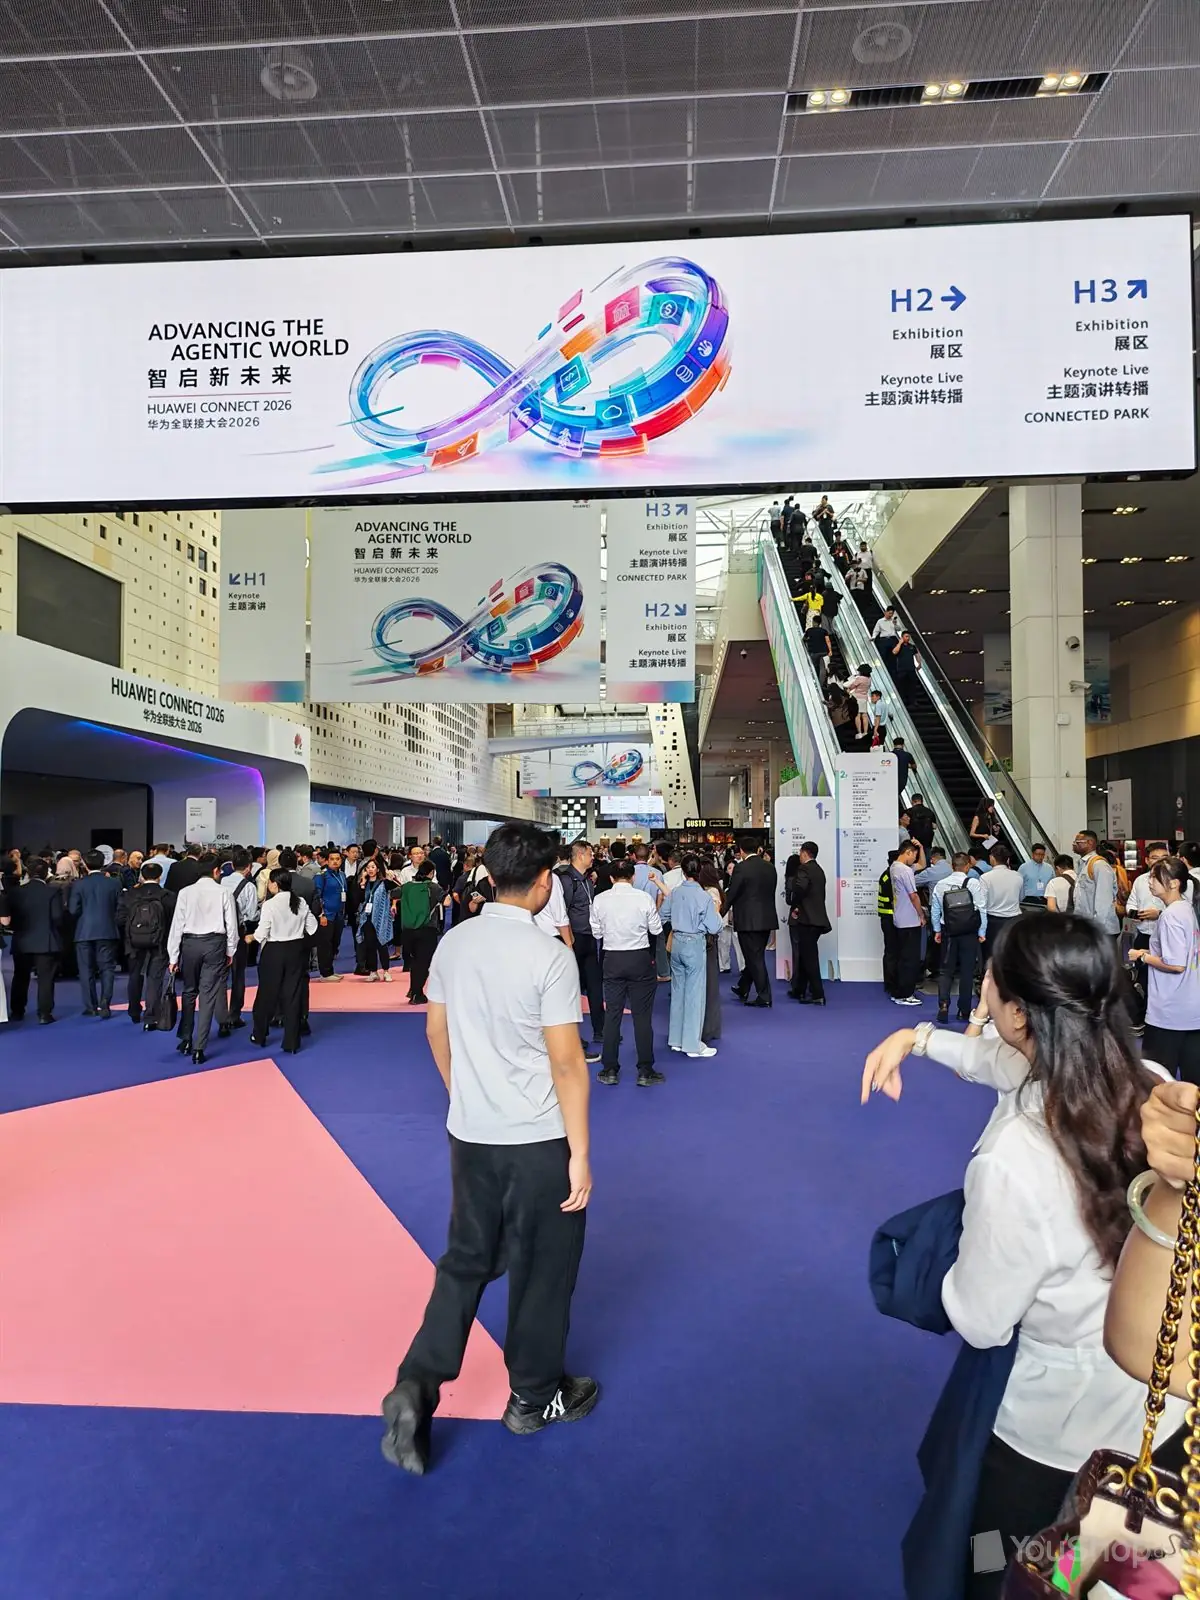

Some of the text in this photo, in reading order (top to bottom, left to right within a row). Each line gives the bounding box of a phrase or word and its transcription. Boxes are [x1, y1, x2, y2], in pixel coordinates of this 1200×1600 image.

[1073, 279, 1118, 304] H3
[890, 288, 934, 313] H2
[148, 318, 324, 341] ADVANCING THE
[1075, 318, 1149, 333] Exhibition
[892, 327, 964, 341] Exhibition
[171, 338, 349, 361] AGENTIC WORLD
[1114, 335, 1149, 351] 展区
[930, 344, 964, 359] 展区
[147, 364, 292, 389] 智启新未来
[1063, 364, 1149, 379] Keynote Live
[881, 372, 964, 387] Keynote Live
[864, 388, 964, 406] 主题演讲转播
[1046, 380, 1149, 400] 主题演讲转播
[147, 399, 292, 415] HUAWEI CONNECT 2026
[1024, 407, 1150, 423] CONNECTED PARK
[147, 416, 260, 430] 华为全联接大会2026
[646, 503, 671, 517] H3
[354, 521, 457, 533] ADVANCING THE
[646, 523, 688, 531] Exhibition
[367, 533, 472, 544] AGENTIC WORLD
[668, 533, 688, 542] 展区
[354, 547, 439, 560] 智启新未来
[639, 549, 670, 557] Keynote
[629, 558, 687, 568] 主题演讲转播
[385, 567, 420, 575] CONNECT
[616, 573, 687, 582] CONNECTED PARK
[244, 572, 266, 586] H1
[228, 592, 260, 600] Keynote
[228, 601, 266, 611] 主题演讲
[645, 603, 670, 617] H2
[645, 623, 687, 631] Exhibition
[667, 633, 687, 642] 展区
[638, 648, 687, 657] Keynote Live
[629, 658, 686, 668] 主题演讲转播
[111, 677, 225, 723] HUAWEI CONNECT 2026
[187, 719, 202, 734] 2026
[815, 802, 830, 820] 1F
[686, 820, 706, 828] GUSTO
